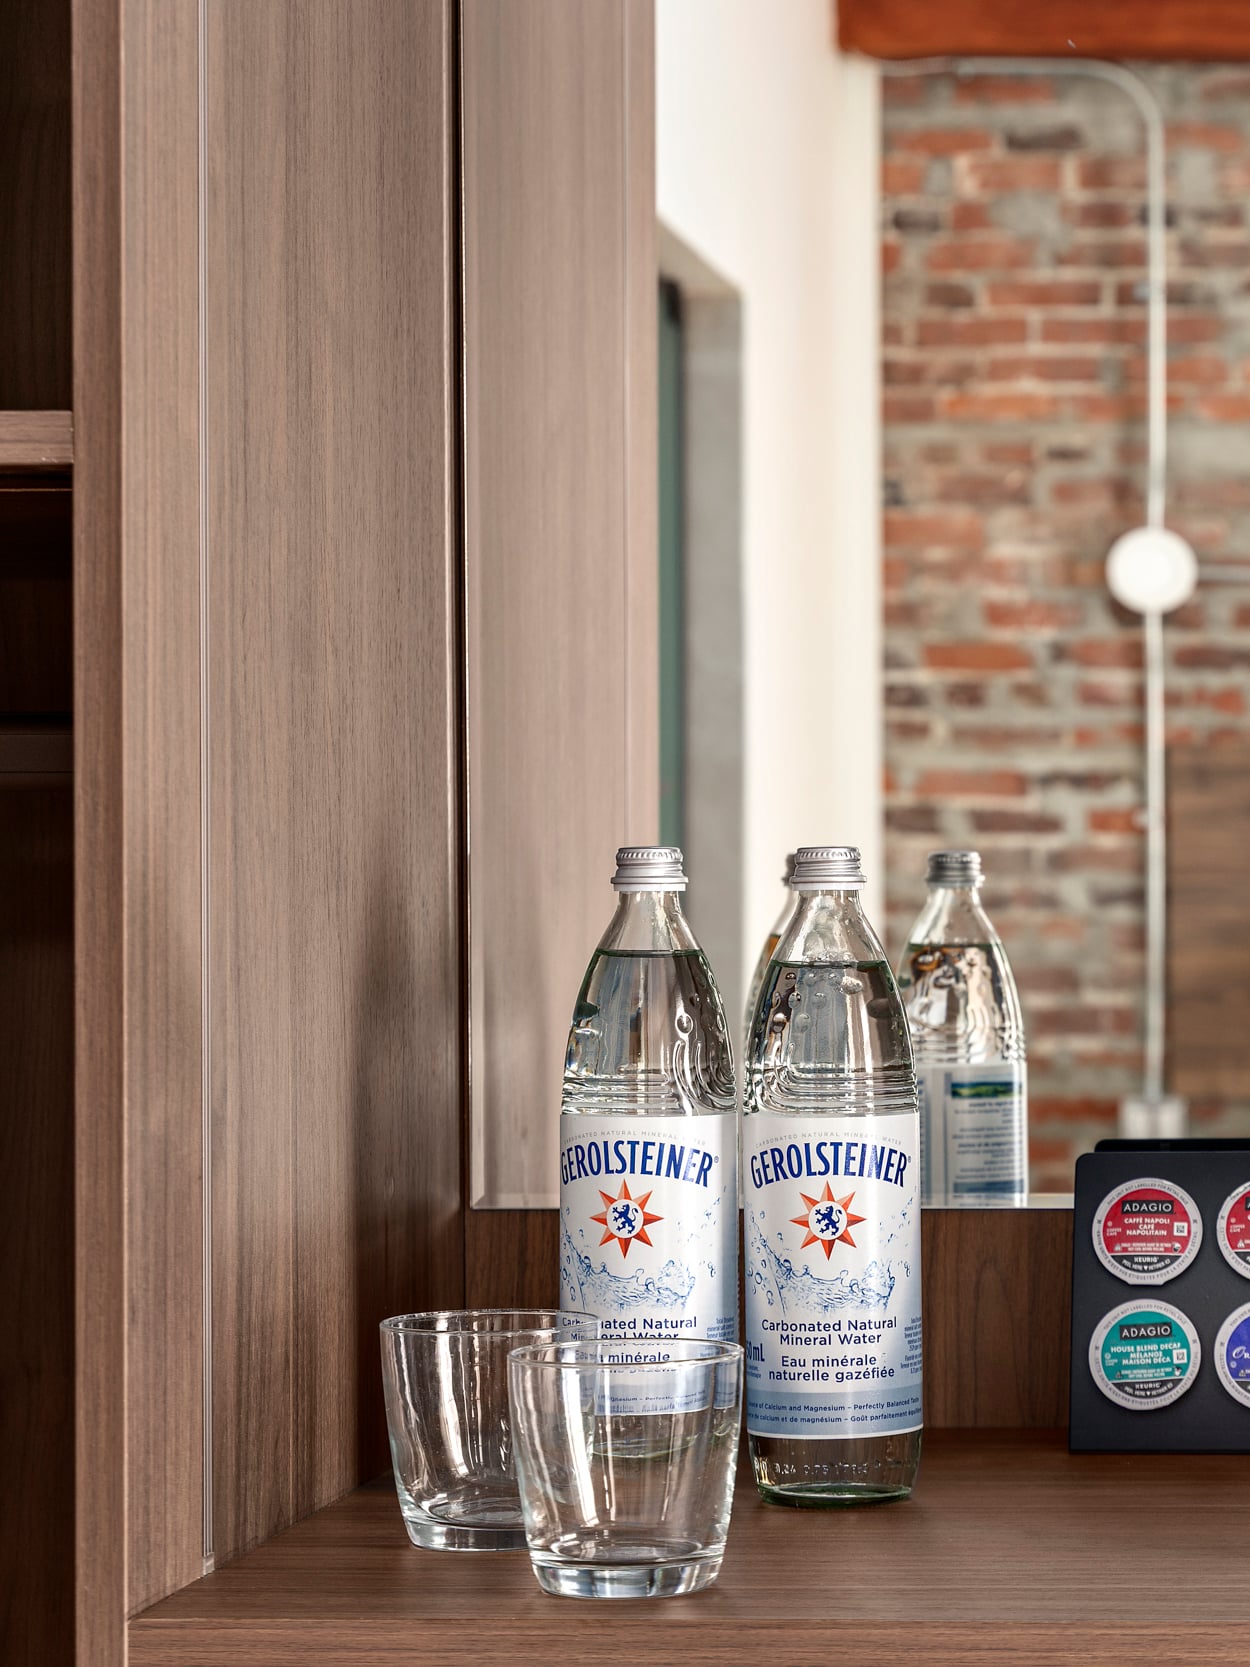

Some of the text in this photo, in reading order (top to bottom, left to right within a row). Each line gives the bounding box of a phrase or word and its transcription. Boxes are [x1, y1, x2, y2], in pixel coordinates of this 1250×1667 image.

[1123, 1203, 1172, 1212] ADAGIO
[643, 1316, 697, 1330] Natural
[761, 1316, 897, 1332] Carbonated Natural
[1122, 1325, 1171, 1338] ADAGIO
[780, 1333, 882, 1346] Mineral Water
[608, 1352, 671, 1364] minérale
[781, 1354, 877, 1368] Eau minérale
[768, 1369, 830, 1381] naturelle
[835, 1366, 895, 1383] gazéfiée
[765, 1403, 787, 1411] Calcium
[803, 1405, 846, 1413] Magnesium
[853, 1402, 885, 1411] Perfectly
[886, 1399, 910, 1408] Balanced
[800, 1416, 842, 1424] magnésium
